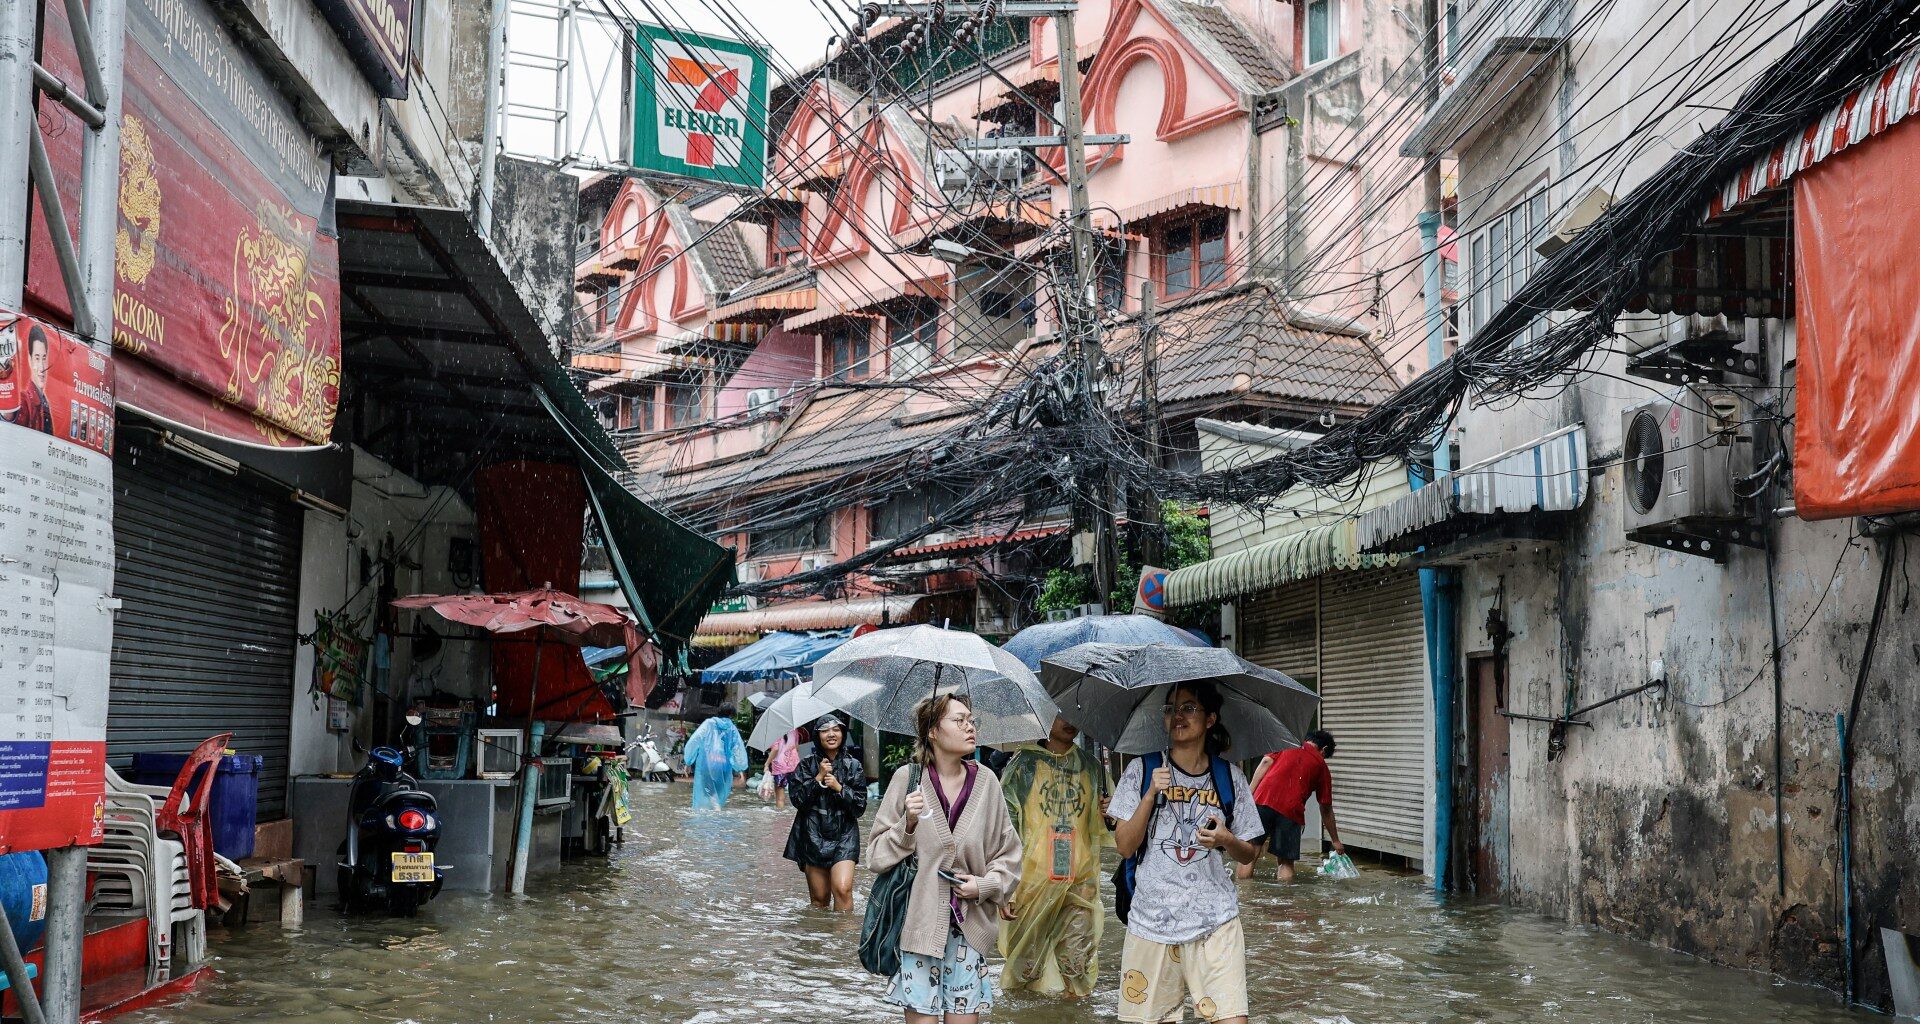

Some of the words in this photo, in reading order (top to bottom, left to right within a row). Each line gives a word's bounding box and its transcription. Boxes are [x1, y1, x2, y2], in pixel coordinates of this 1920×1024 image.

[1670, 436, 1680, 449] LG
[1197, 788, 1221, 807] TU
[398, 872, 427, 880] 5351
